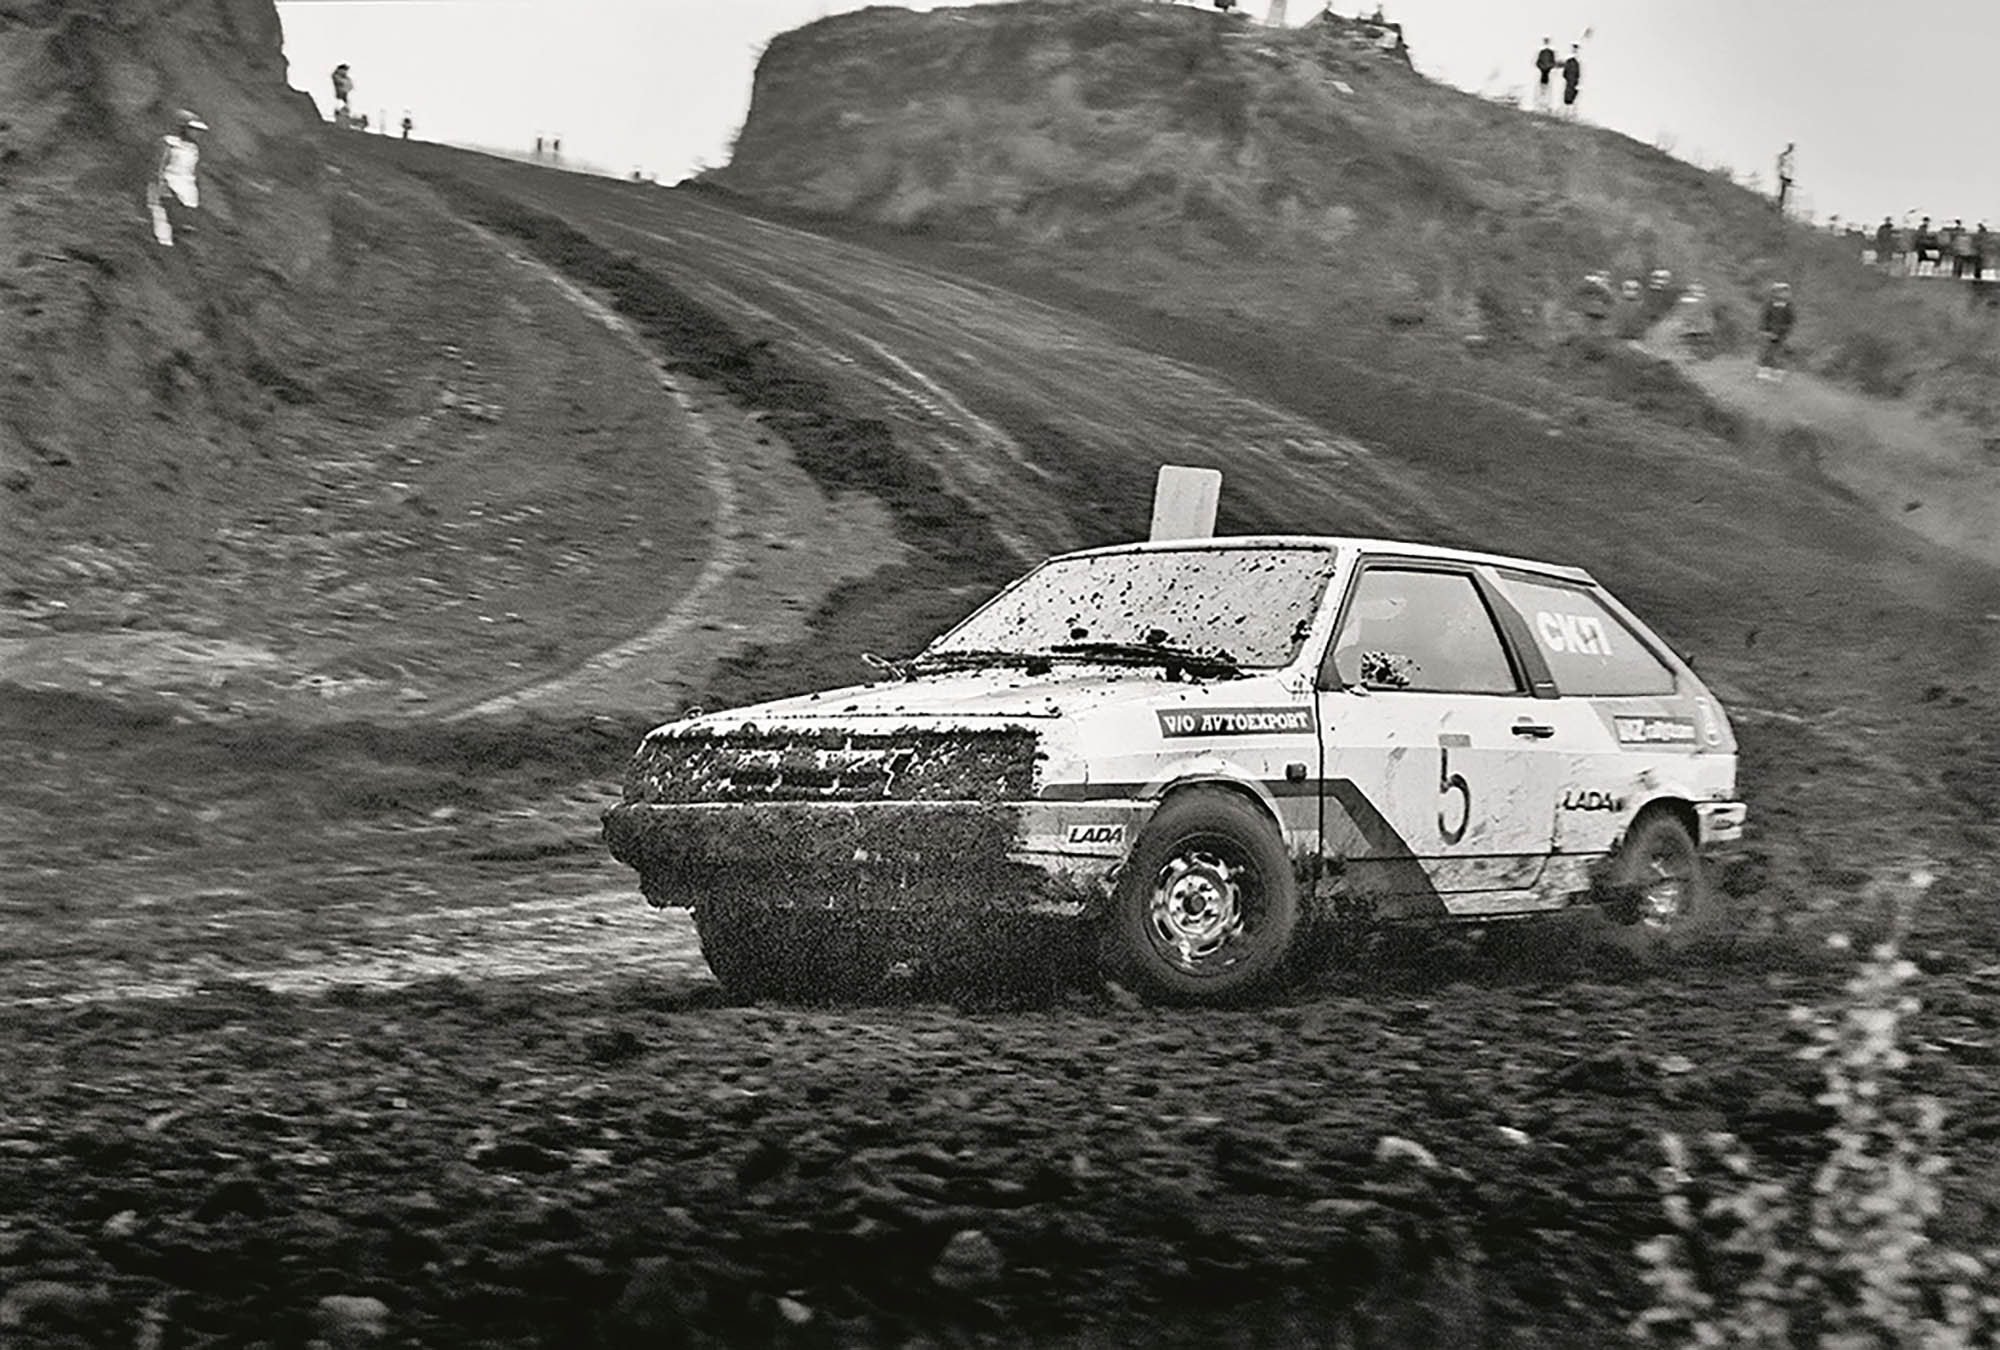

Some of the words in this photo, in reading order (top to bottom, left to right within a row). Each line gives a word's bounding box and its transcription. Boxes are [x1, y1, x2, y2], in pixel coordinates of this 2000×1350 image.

[1163, 715, 1195, 733] V/O
[1200, 711, 1308, 732] AVTOEXPORT
[1438, 733, 1471, 846] 5
[1563, 791, 1614, 812] LADA
[1068, 827, 1122, 844] LADA
